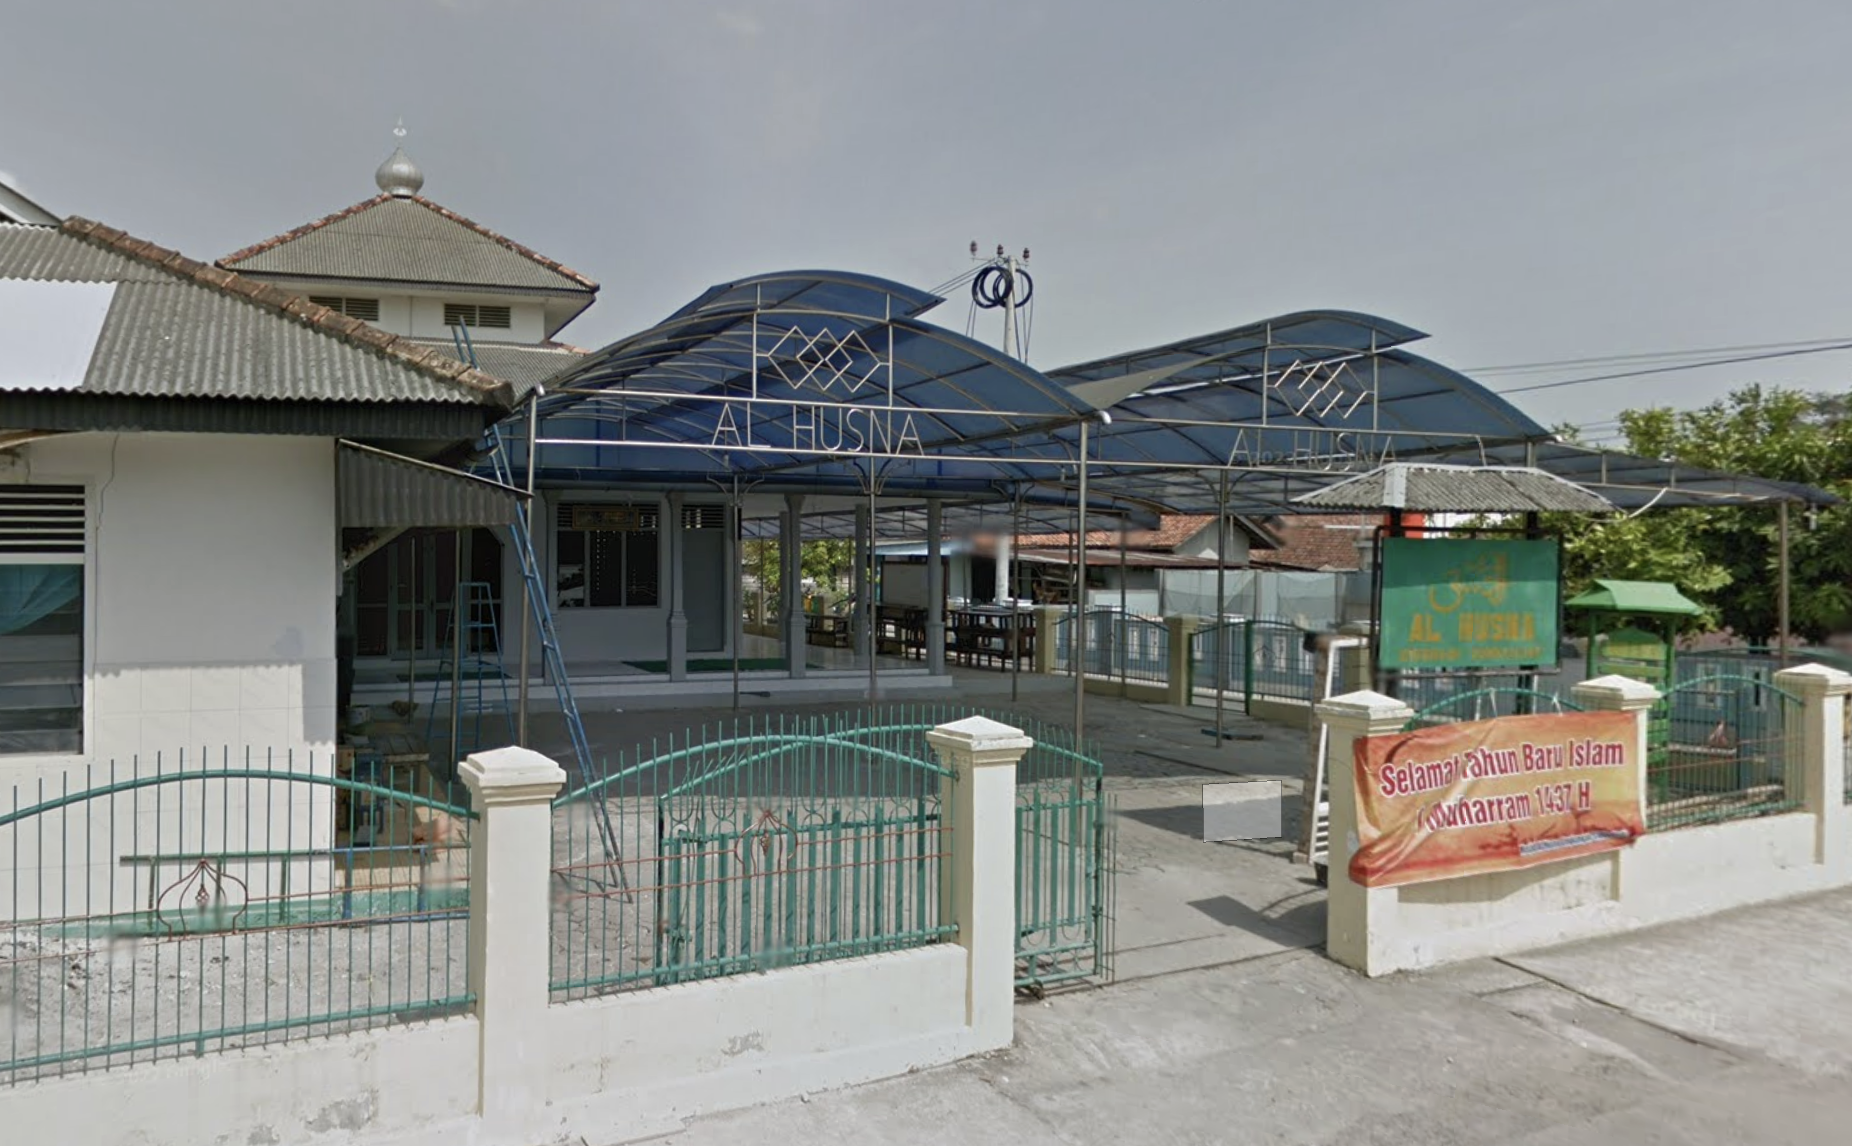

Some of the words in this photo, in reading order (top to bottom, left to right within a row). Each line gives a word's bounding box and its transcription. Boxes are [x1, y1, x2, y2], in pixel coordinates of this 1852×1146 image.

[712, 403, 771, 448] AL
[794, 405, 925, 456] HUSNA
[1409, 612, 1442, 642] AL
[1522, 743, 1564, 772] Baru
[1568, 739, 1625, 768] Islam
[1535, 784, 1573, 816] 1437
[1577, 781, 1591, 811] H
